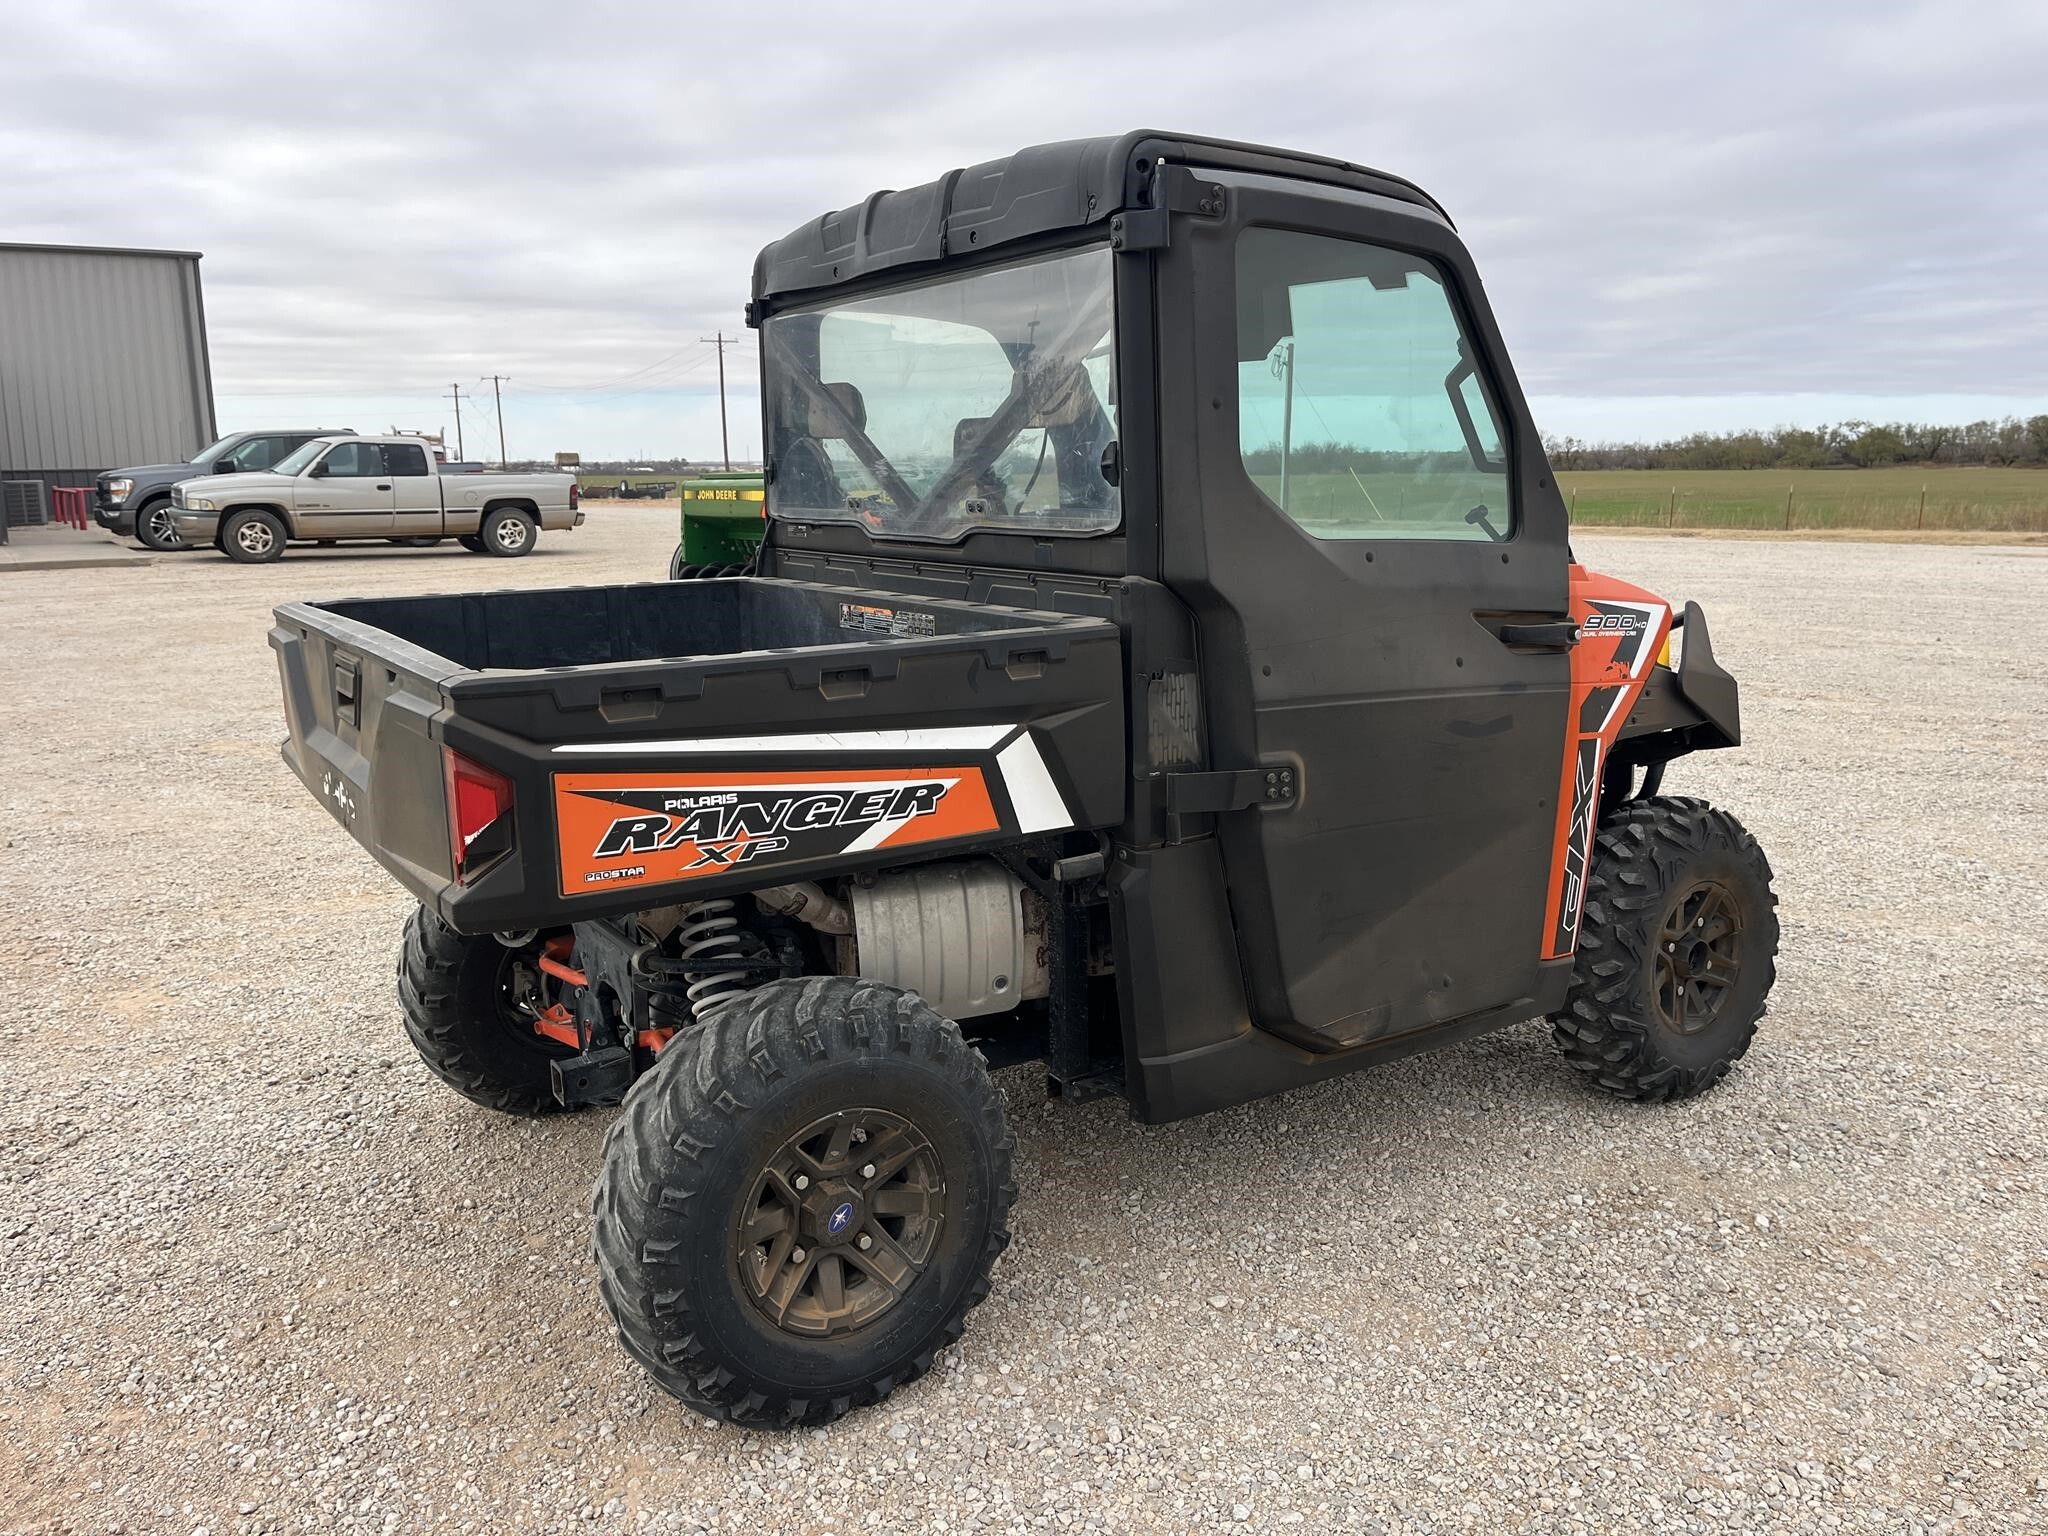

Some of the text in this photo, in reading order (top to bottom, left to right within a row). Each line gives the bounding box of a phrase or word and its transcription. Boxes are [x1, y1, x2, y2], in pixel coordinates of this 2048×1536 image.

[697, 489, 737, 500] JOHN DEERE
[664, 793, 738, 811] POLARIS
[592, 782, 949, 858] RANGER
[679, 836, 789, 871] XP
[584, 866, 646, 883] PROSTAR
